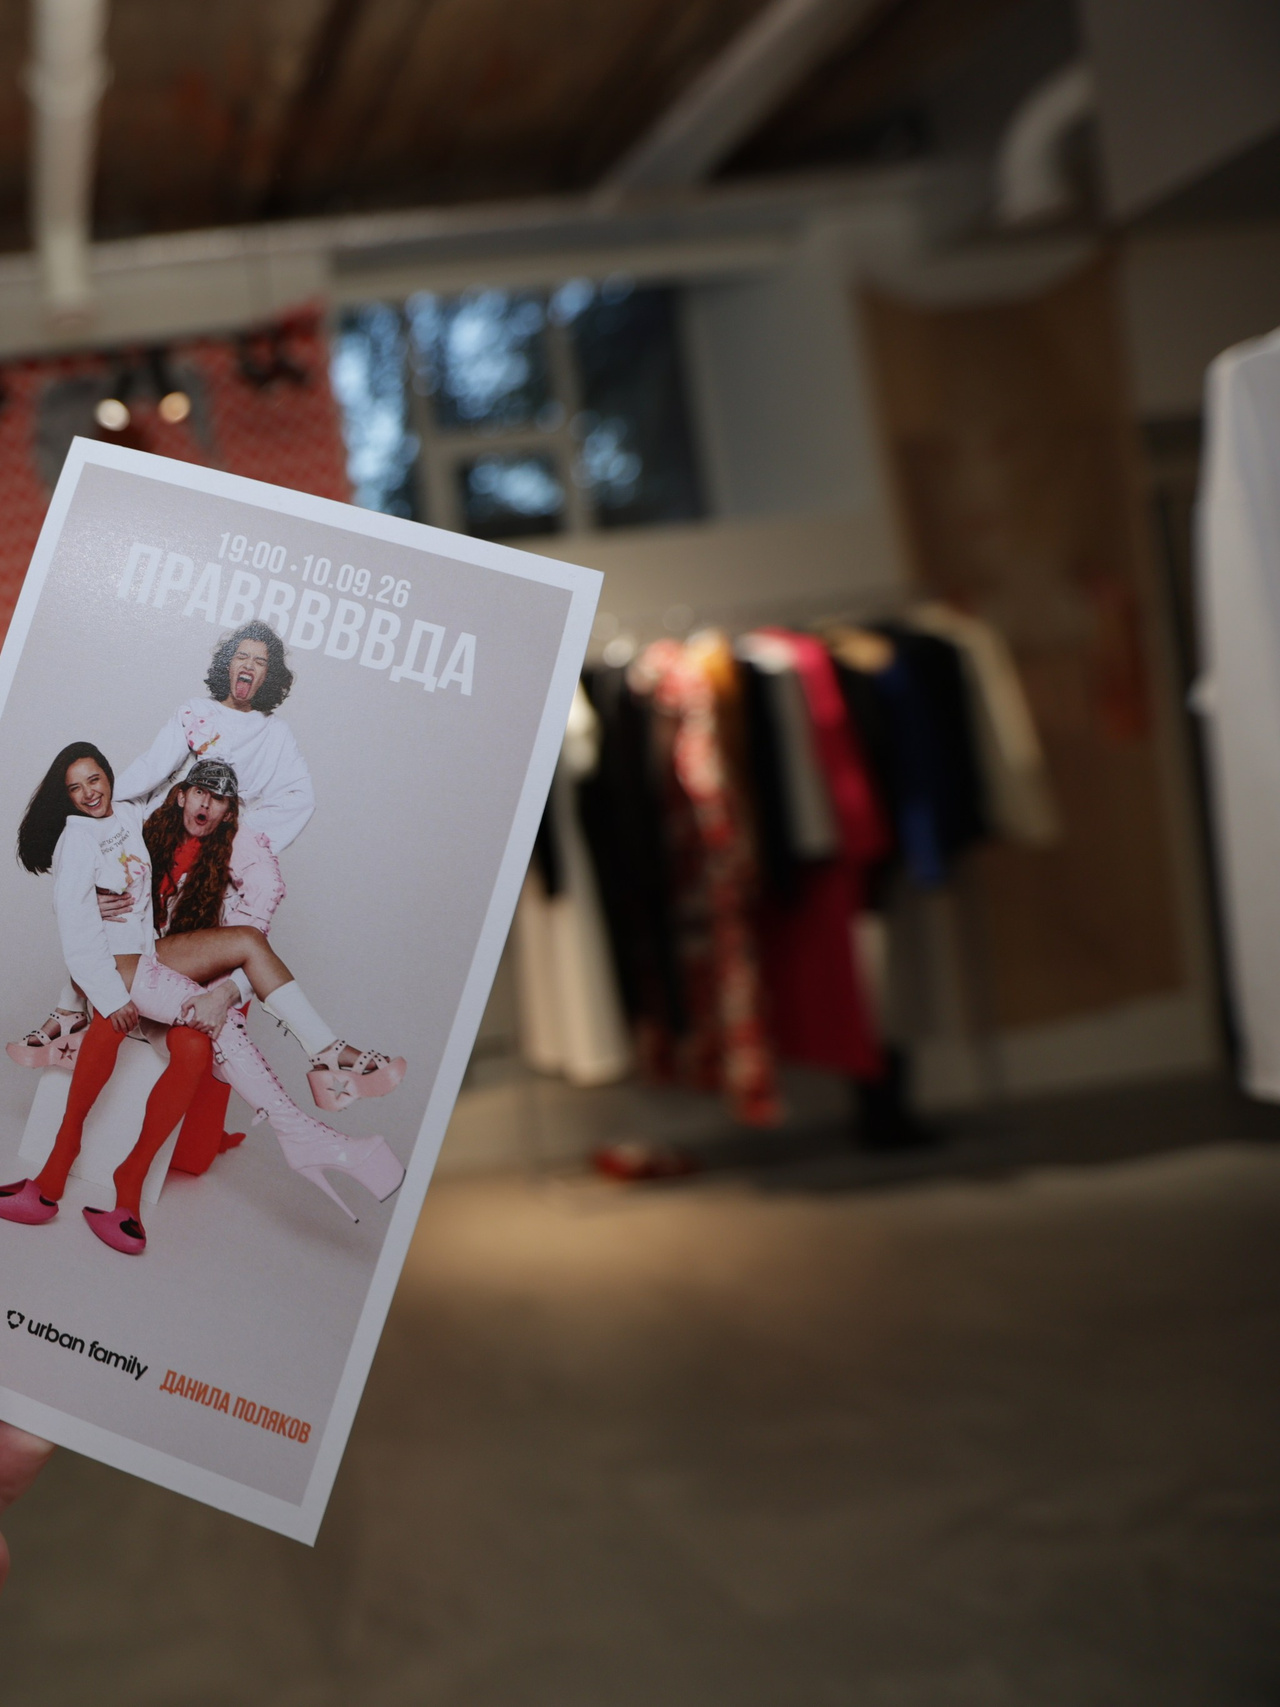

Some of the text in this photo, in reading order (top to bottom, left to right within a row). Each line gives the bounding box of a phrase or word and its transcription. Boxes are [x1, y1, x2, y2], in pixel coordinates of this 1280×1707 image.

[218, 532, 412, 608] 19:00 10.09.26
[27, 1319, 149, 1381] urban family
[159, 1369, 312, 1444] ДАНИЛА ПОЛЯКОВ
